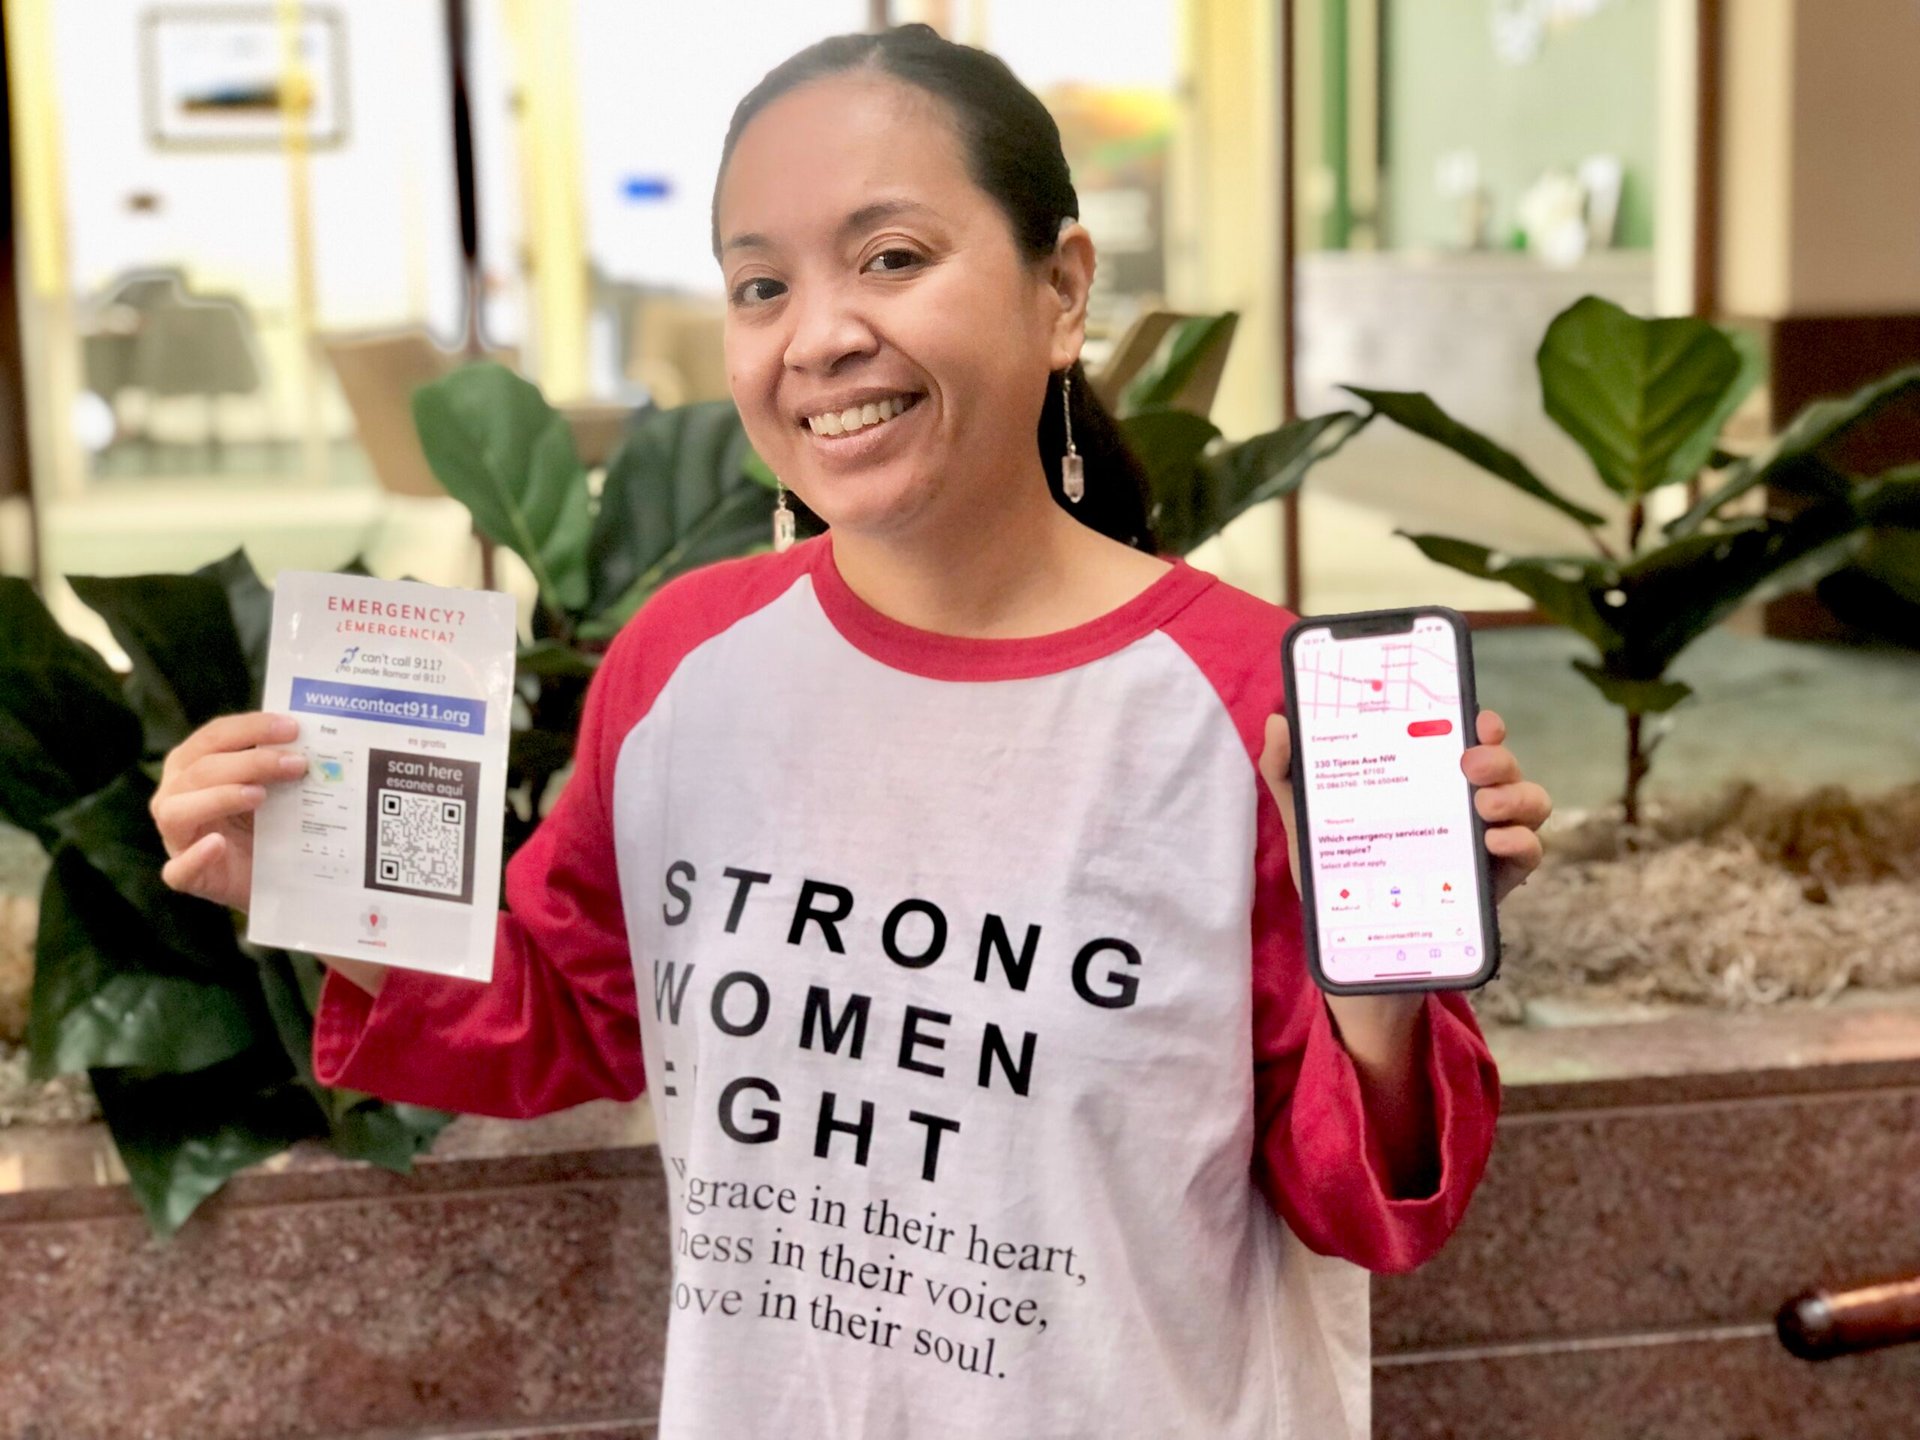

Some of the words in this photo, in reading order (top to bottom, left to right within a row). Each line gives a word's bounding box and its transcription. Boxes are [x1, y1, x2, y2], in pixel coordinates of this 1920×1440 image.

[328, 596, 465, 625] EMERGENCY?
[336, 619, 455, 643] ¿EMERGENCIA?
[361, 653, 388, 665] can't
[391, 656, 411, 667] call
[414, 657, 443, 671] 911?
[305, 691, 471, 727] www.contact911.org
[388, 760, 425, 776] scan
[428, 761, 464, 781] here
[1362, 757, 1378, 765] Ave
[1379, 754, 1396, 763] NW
[386, 776, 435, 792] escanee
[1318, 834, 1344, 844] Which
[1346, 832, 1393, 842] emergency
[1437, 826, 1449, 836] do
[1319, 849, 1335, 858] you
[1337, 845, 1371, 856] require?
[663, 860, 1142, 1010] STRONG
[654, 959, 1038, 1098] WOMEN
[664, 1060, 960, 1182] GHT
[686, 1176, 797, 1215] grace
[809, 1185, 847, 1229] in
[863, 1198, 955, 1256] their
[967, 1224, 1088, 1286] heart,
[769, 1228, 805, 1271] in
[820, 1243, 913, 1297] their
[924, 1276, 1049, 1334] voice,
[758, 1278, 798, 1322] in
[809, 1294, 902, 1350] their
[912, 1326, 1006, 1379] soul.
